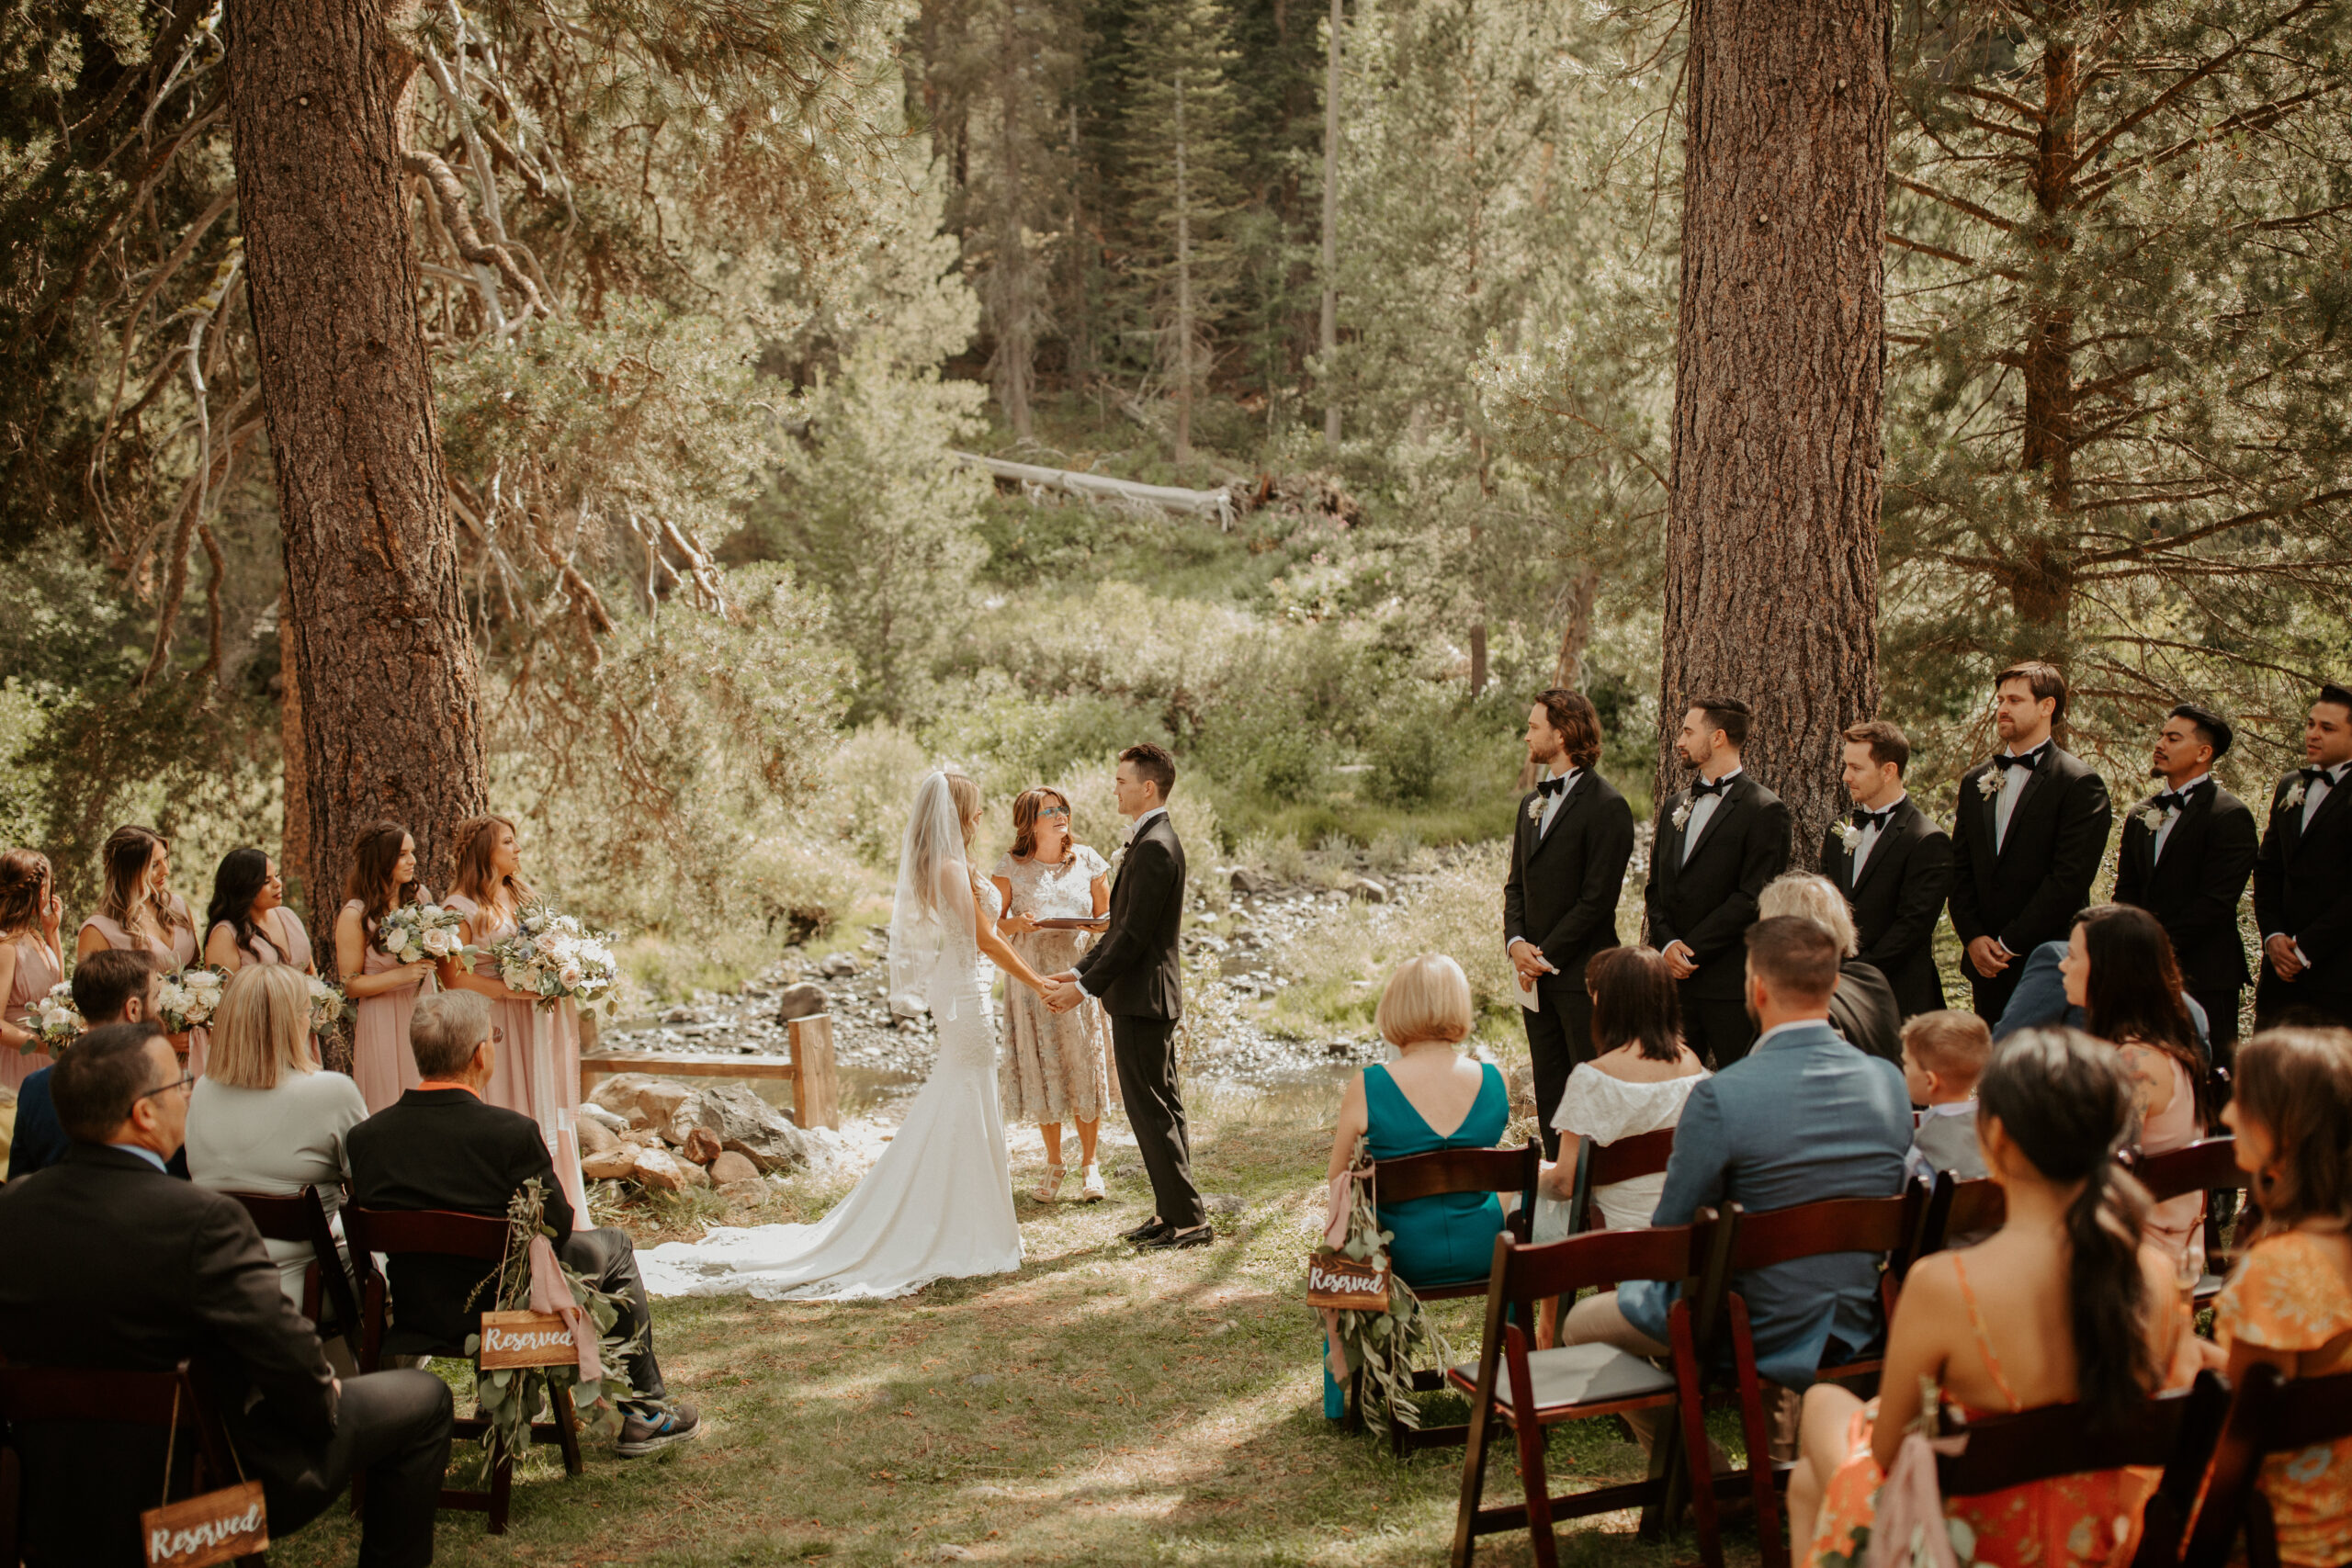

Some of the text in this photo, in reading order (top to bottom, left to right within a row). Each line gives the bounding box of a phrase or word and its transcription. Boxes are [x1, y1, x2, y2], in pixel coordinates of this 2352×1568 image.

[1309, 1267, 1385, 1294] Reserved
[485, 1327, 575, 1352] Reserved
[151, 1503, 262, 1563] Reserved
